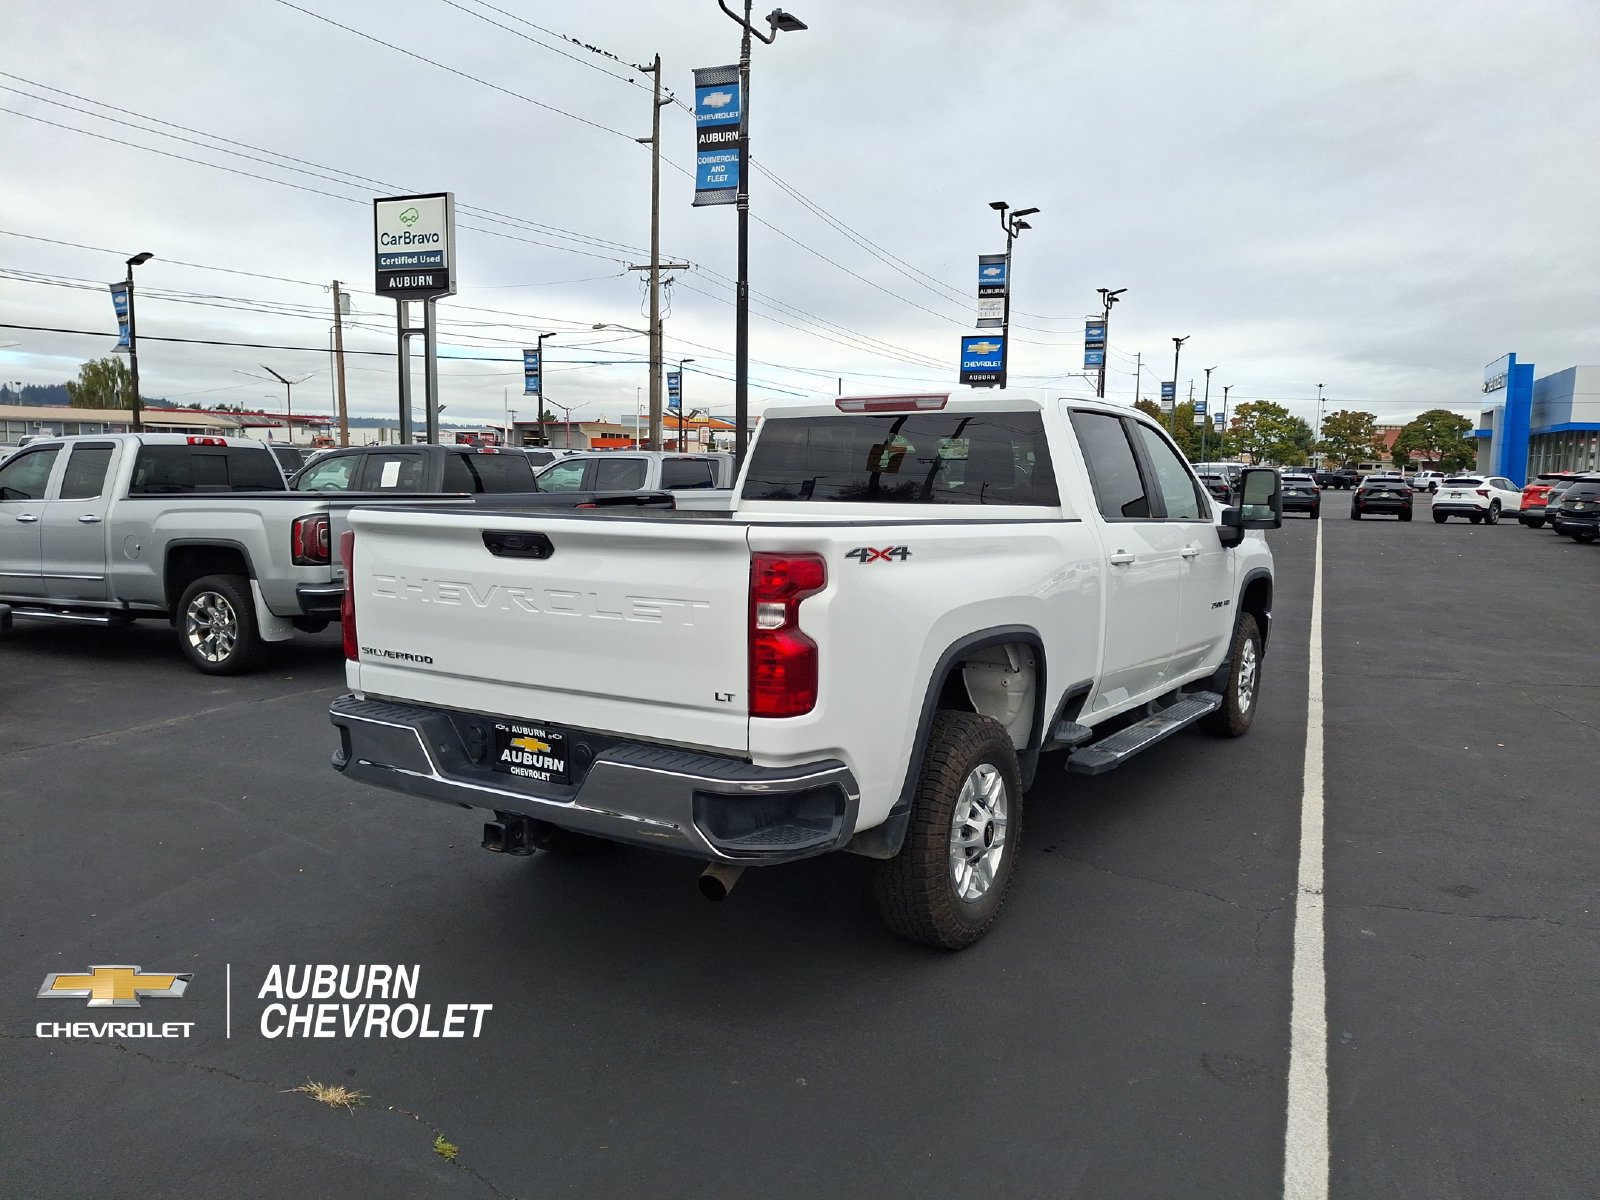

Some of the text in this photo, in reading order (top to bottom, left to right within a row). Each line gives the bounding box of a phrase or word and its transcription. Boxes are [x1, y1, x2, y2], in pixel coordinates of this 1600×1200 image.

[697, 111, 739, 121] CHEVROLET
[699, 131, 739, 144] AUBURN
[698, 154, 739, 165] COMMERCIAL
[711, 165, 726, 173] AND
[381, 231, 440, 246] CarBravo
[381, 255, 441, 265] Certified Used
[389, 275, 433, 288] AUBURN
[963, 360, 1002, 368] CHEVROLET
[372, 574, 711, 626] CHEVROLET
[361, 646, 434, 664] SILVERADO
[714, 692, 736, 702] LT
[511, 725, 546, 738] AUBURN
[500, 749, 565, 772] AUBURN
[510, 766, 551, 781] CHEVROLET
